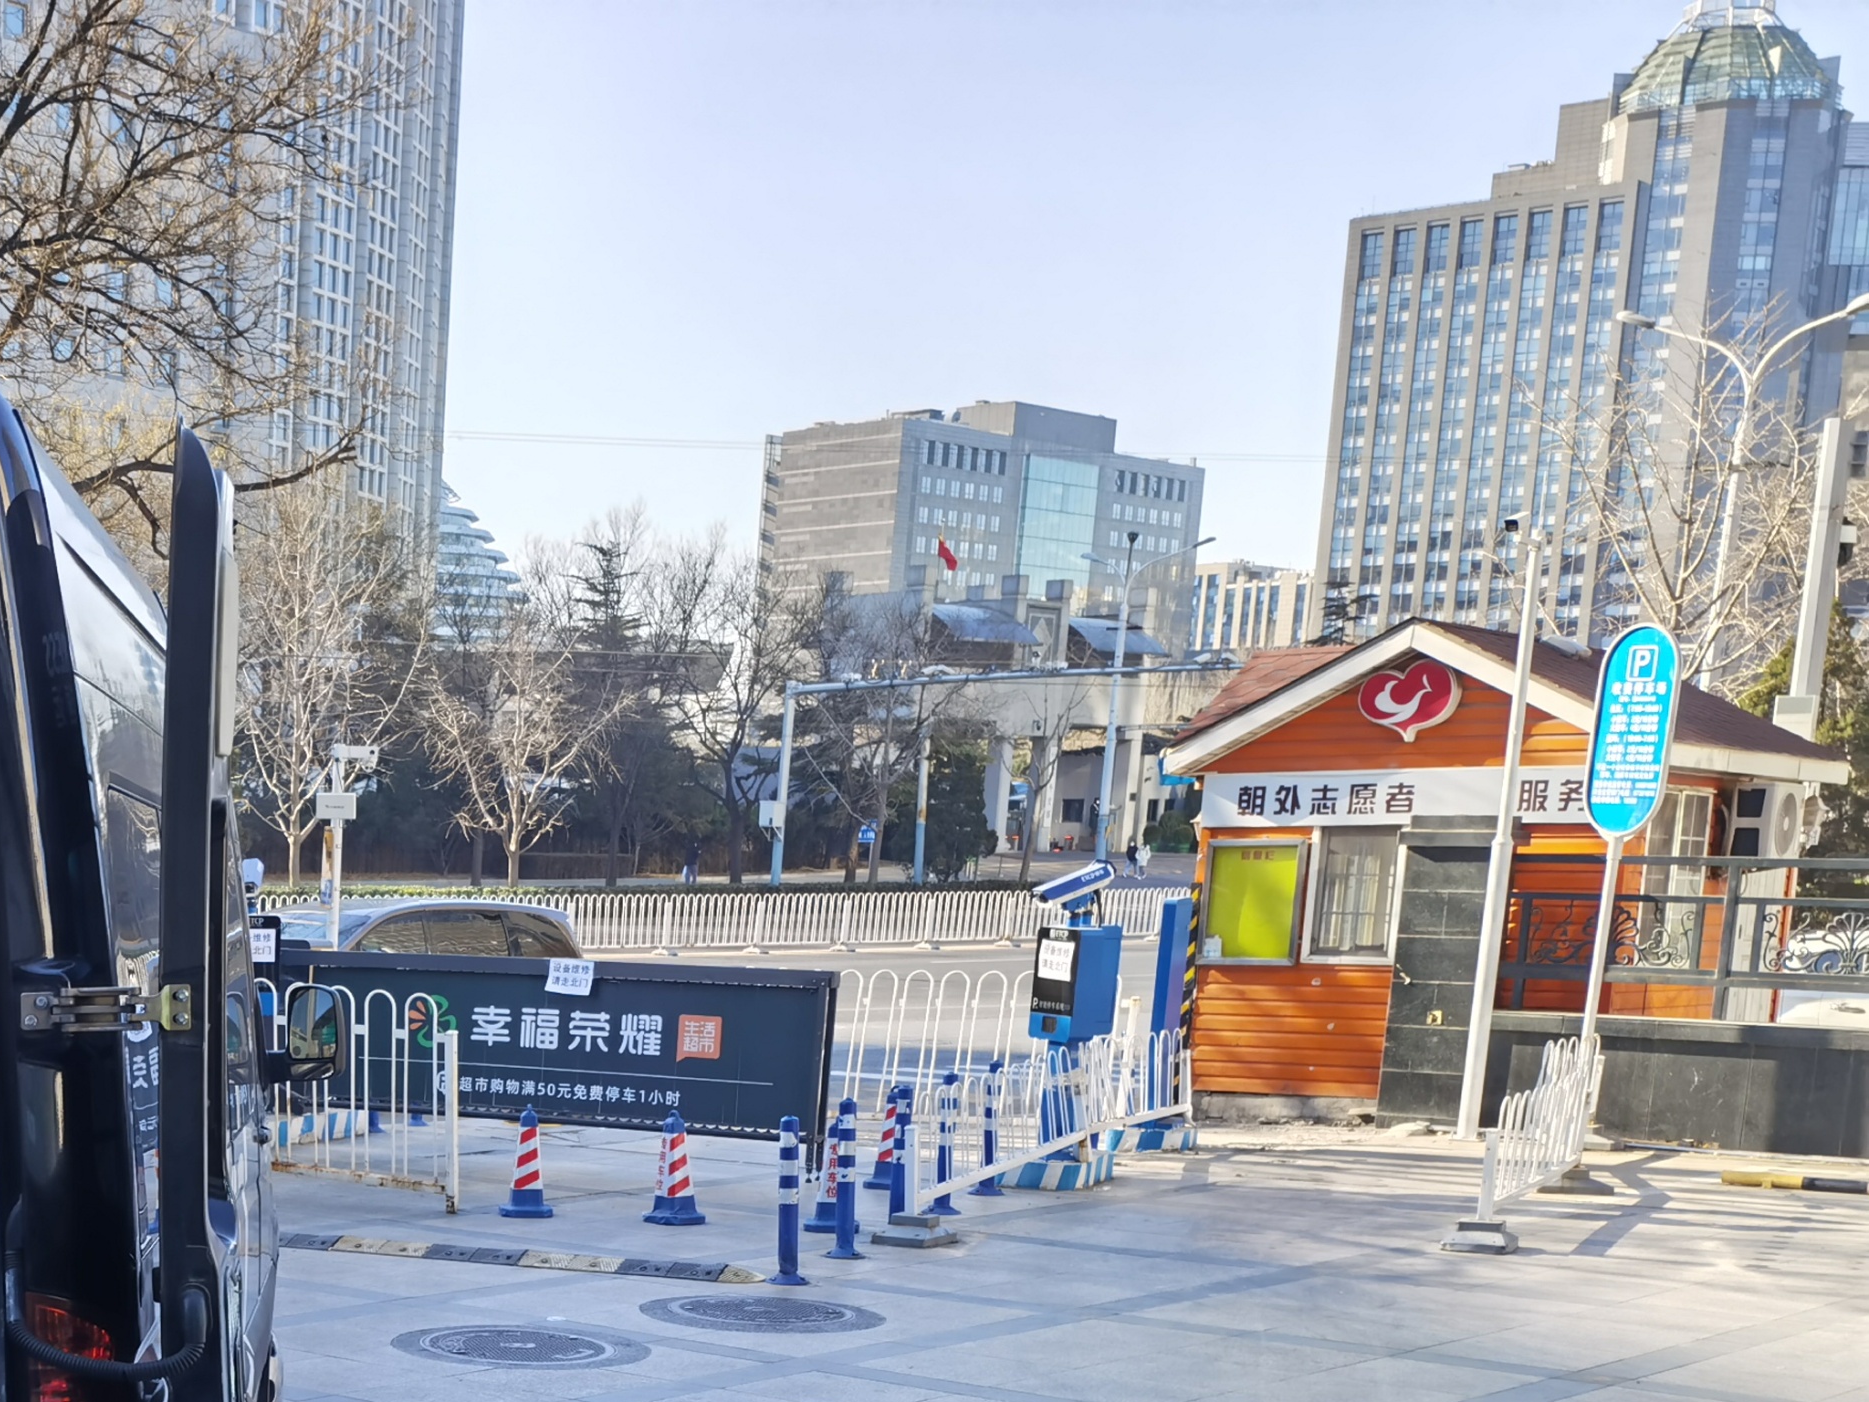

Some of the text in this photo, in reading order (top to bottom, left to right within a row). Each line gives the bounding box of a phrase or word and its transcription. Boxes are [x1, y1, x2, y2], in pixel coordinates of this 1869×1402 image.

[1237, 783, 1415, 815] 朝外志愿者
[552, 962, 590, 975] 设备维修
[550, 975, 589, 989] 请走北门
[470, 1005, 663, 1056] 幸福荣耀
[684, 1020, 716, 1038] 生活
[682, 1036, 715, 1053] 超市
[459, 1076, 681, 1107] 超市购物满50元免费停车1小时
